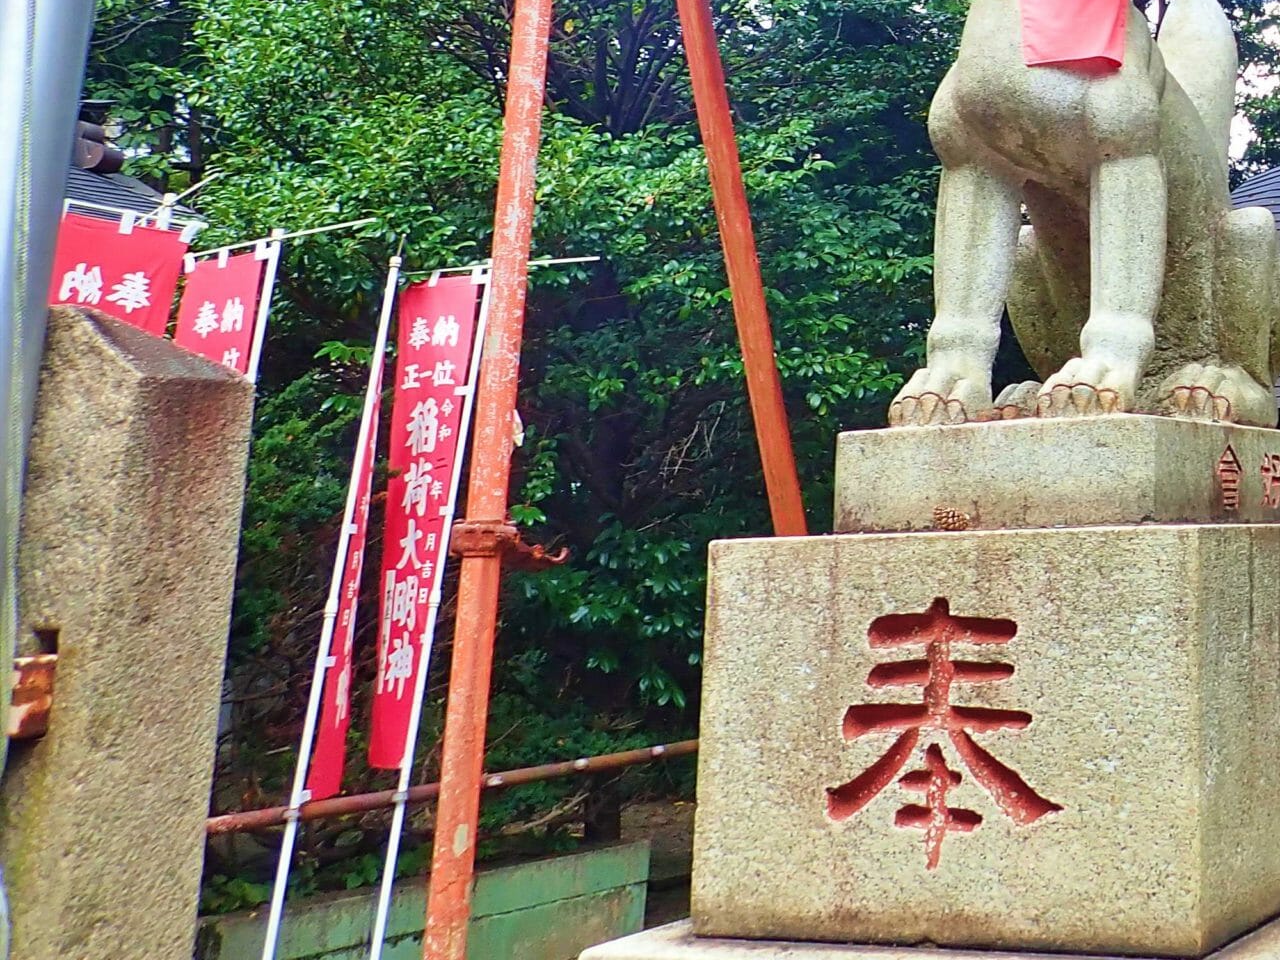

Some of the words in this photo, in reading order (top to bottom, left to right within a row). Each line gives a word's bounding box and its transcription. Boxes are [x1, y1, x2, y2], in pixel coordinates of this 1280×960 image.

[192, 296, 245, 339] 奉納
[407, 315, 460, 351] 奉納
[401, 360, 457, 390] 正一位
[385, 397, 439, 701] 稲荷大明神
[825, 595, 1064, 871] 奉
